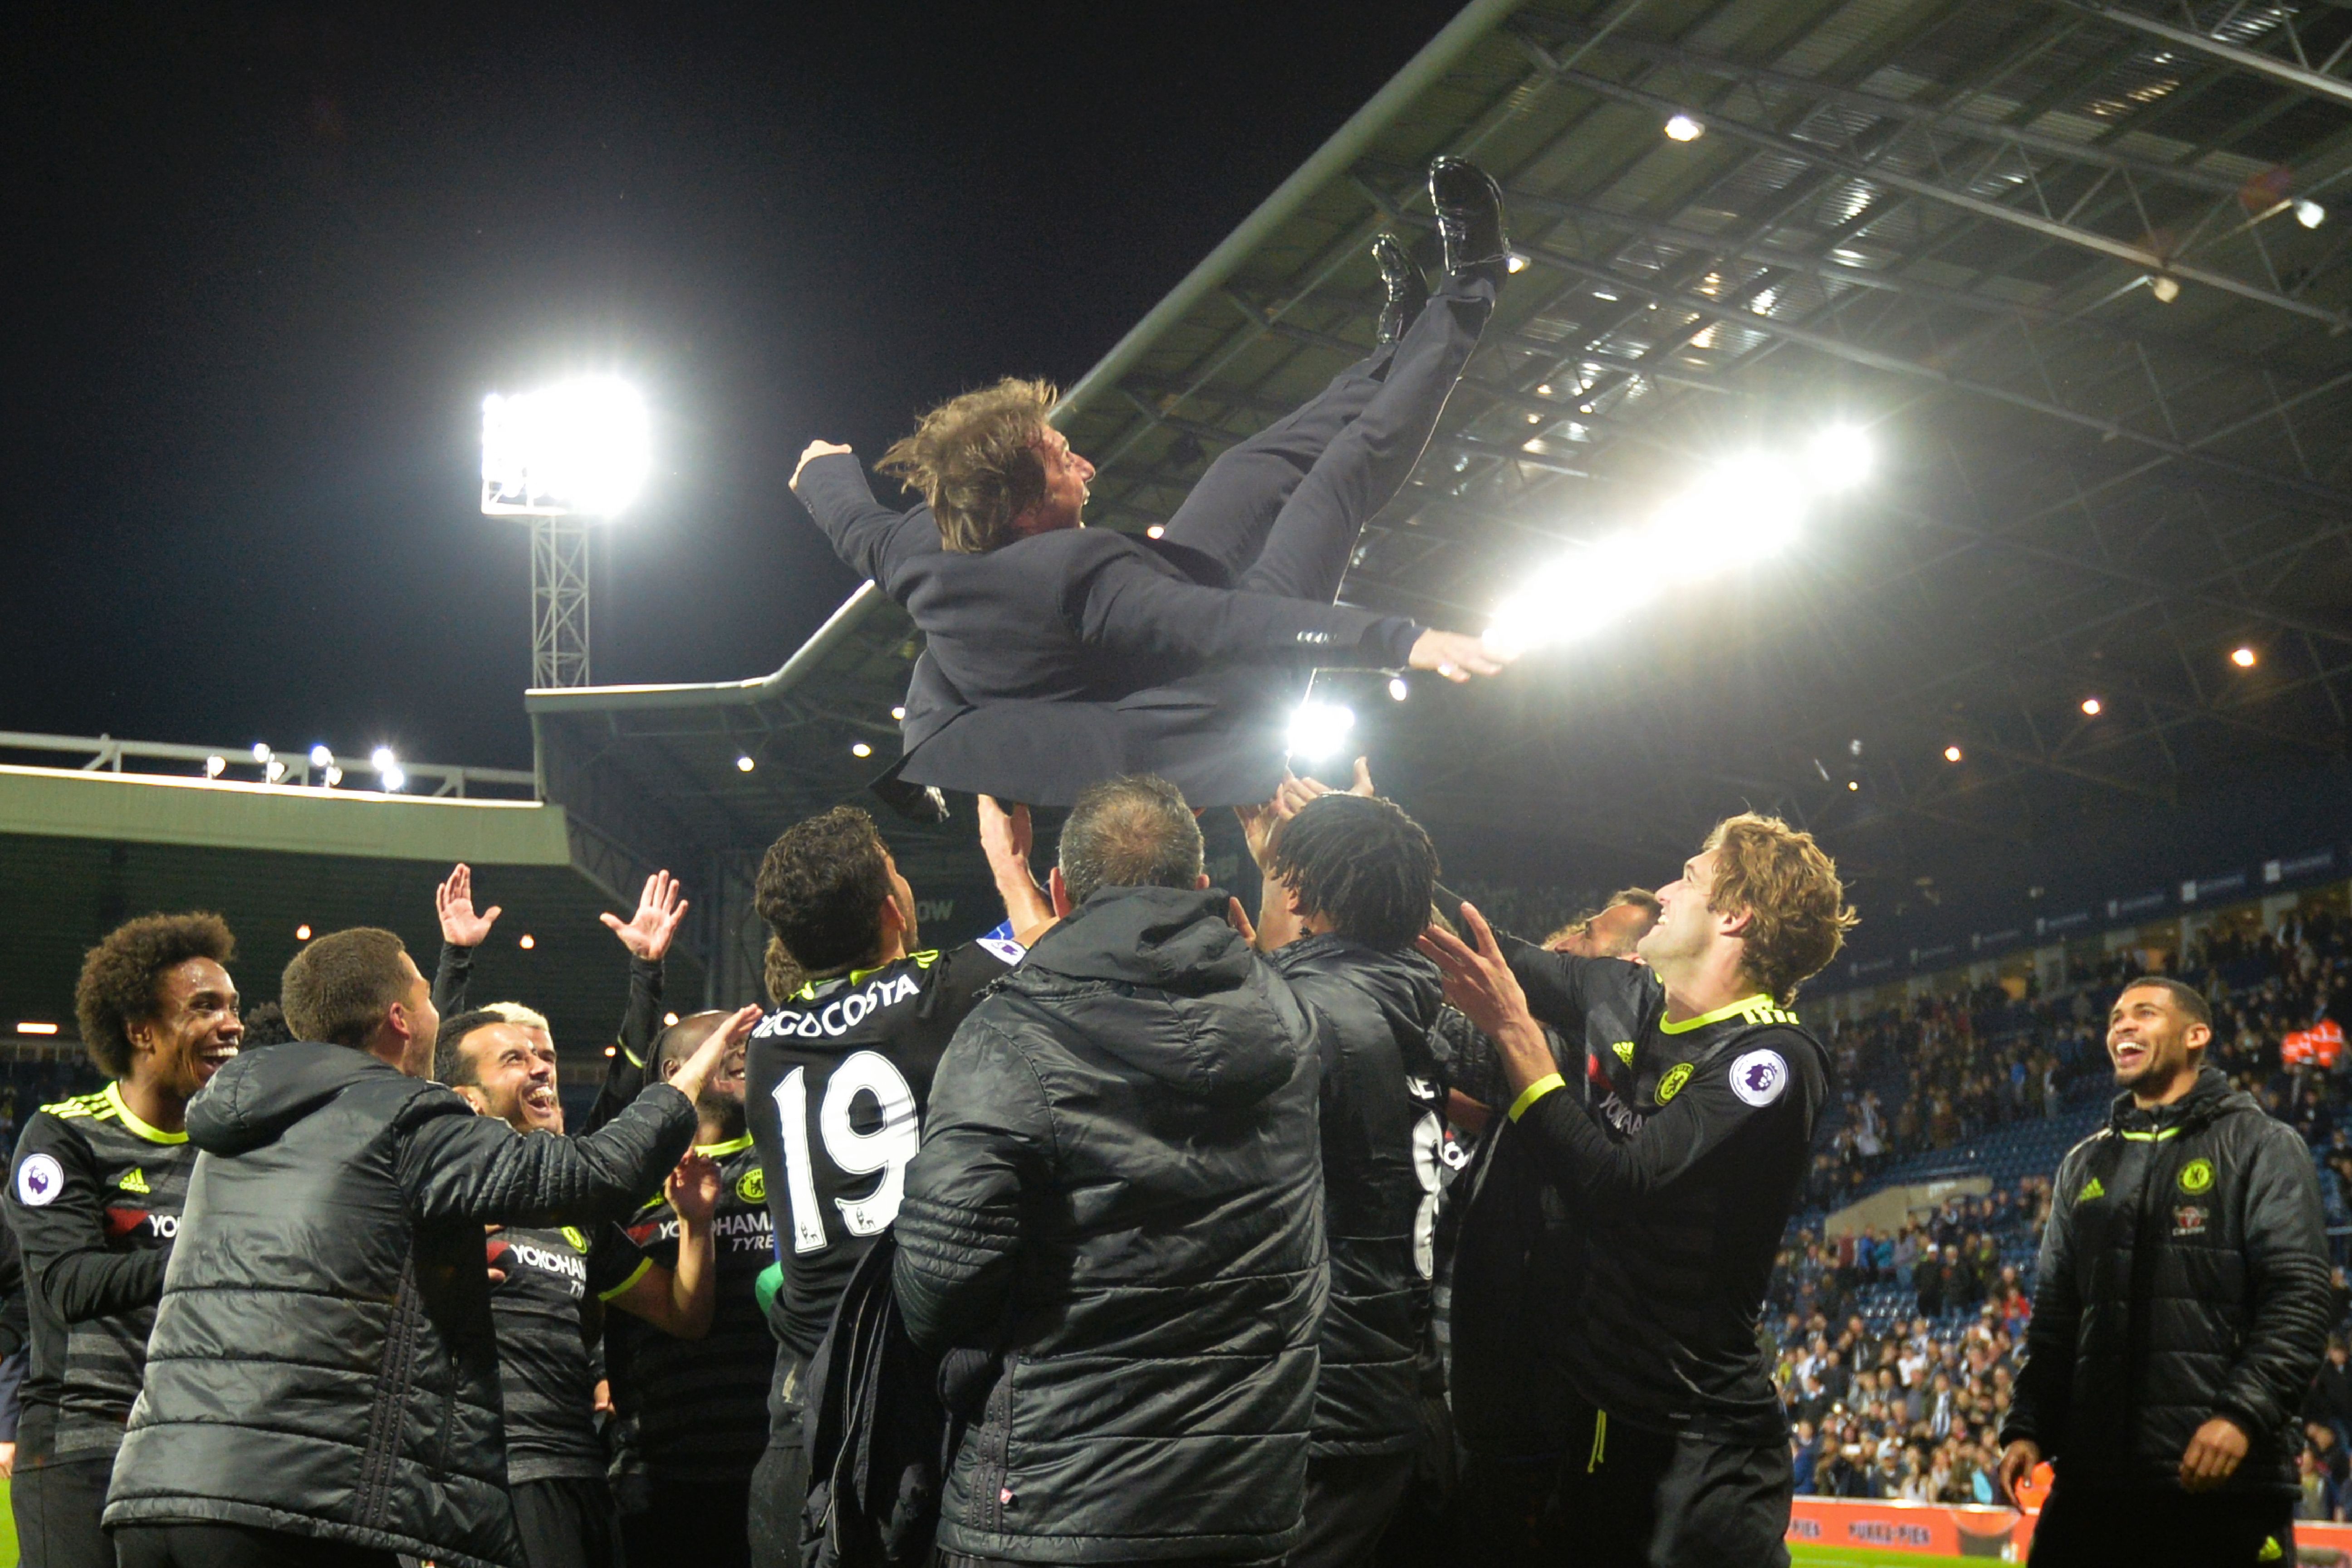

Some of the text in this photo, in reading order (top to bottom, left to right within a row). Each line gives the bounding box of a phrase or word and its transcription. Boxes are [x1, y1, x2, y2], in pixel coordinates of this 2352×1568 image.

[822, 974, 920, 1036] COSTA
[772, 1050, 920, 1254] 19
[732, 1234, 774, 1252] TYRE
